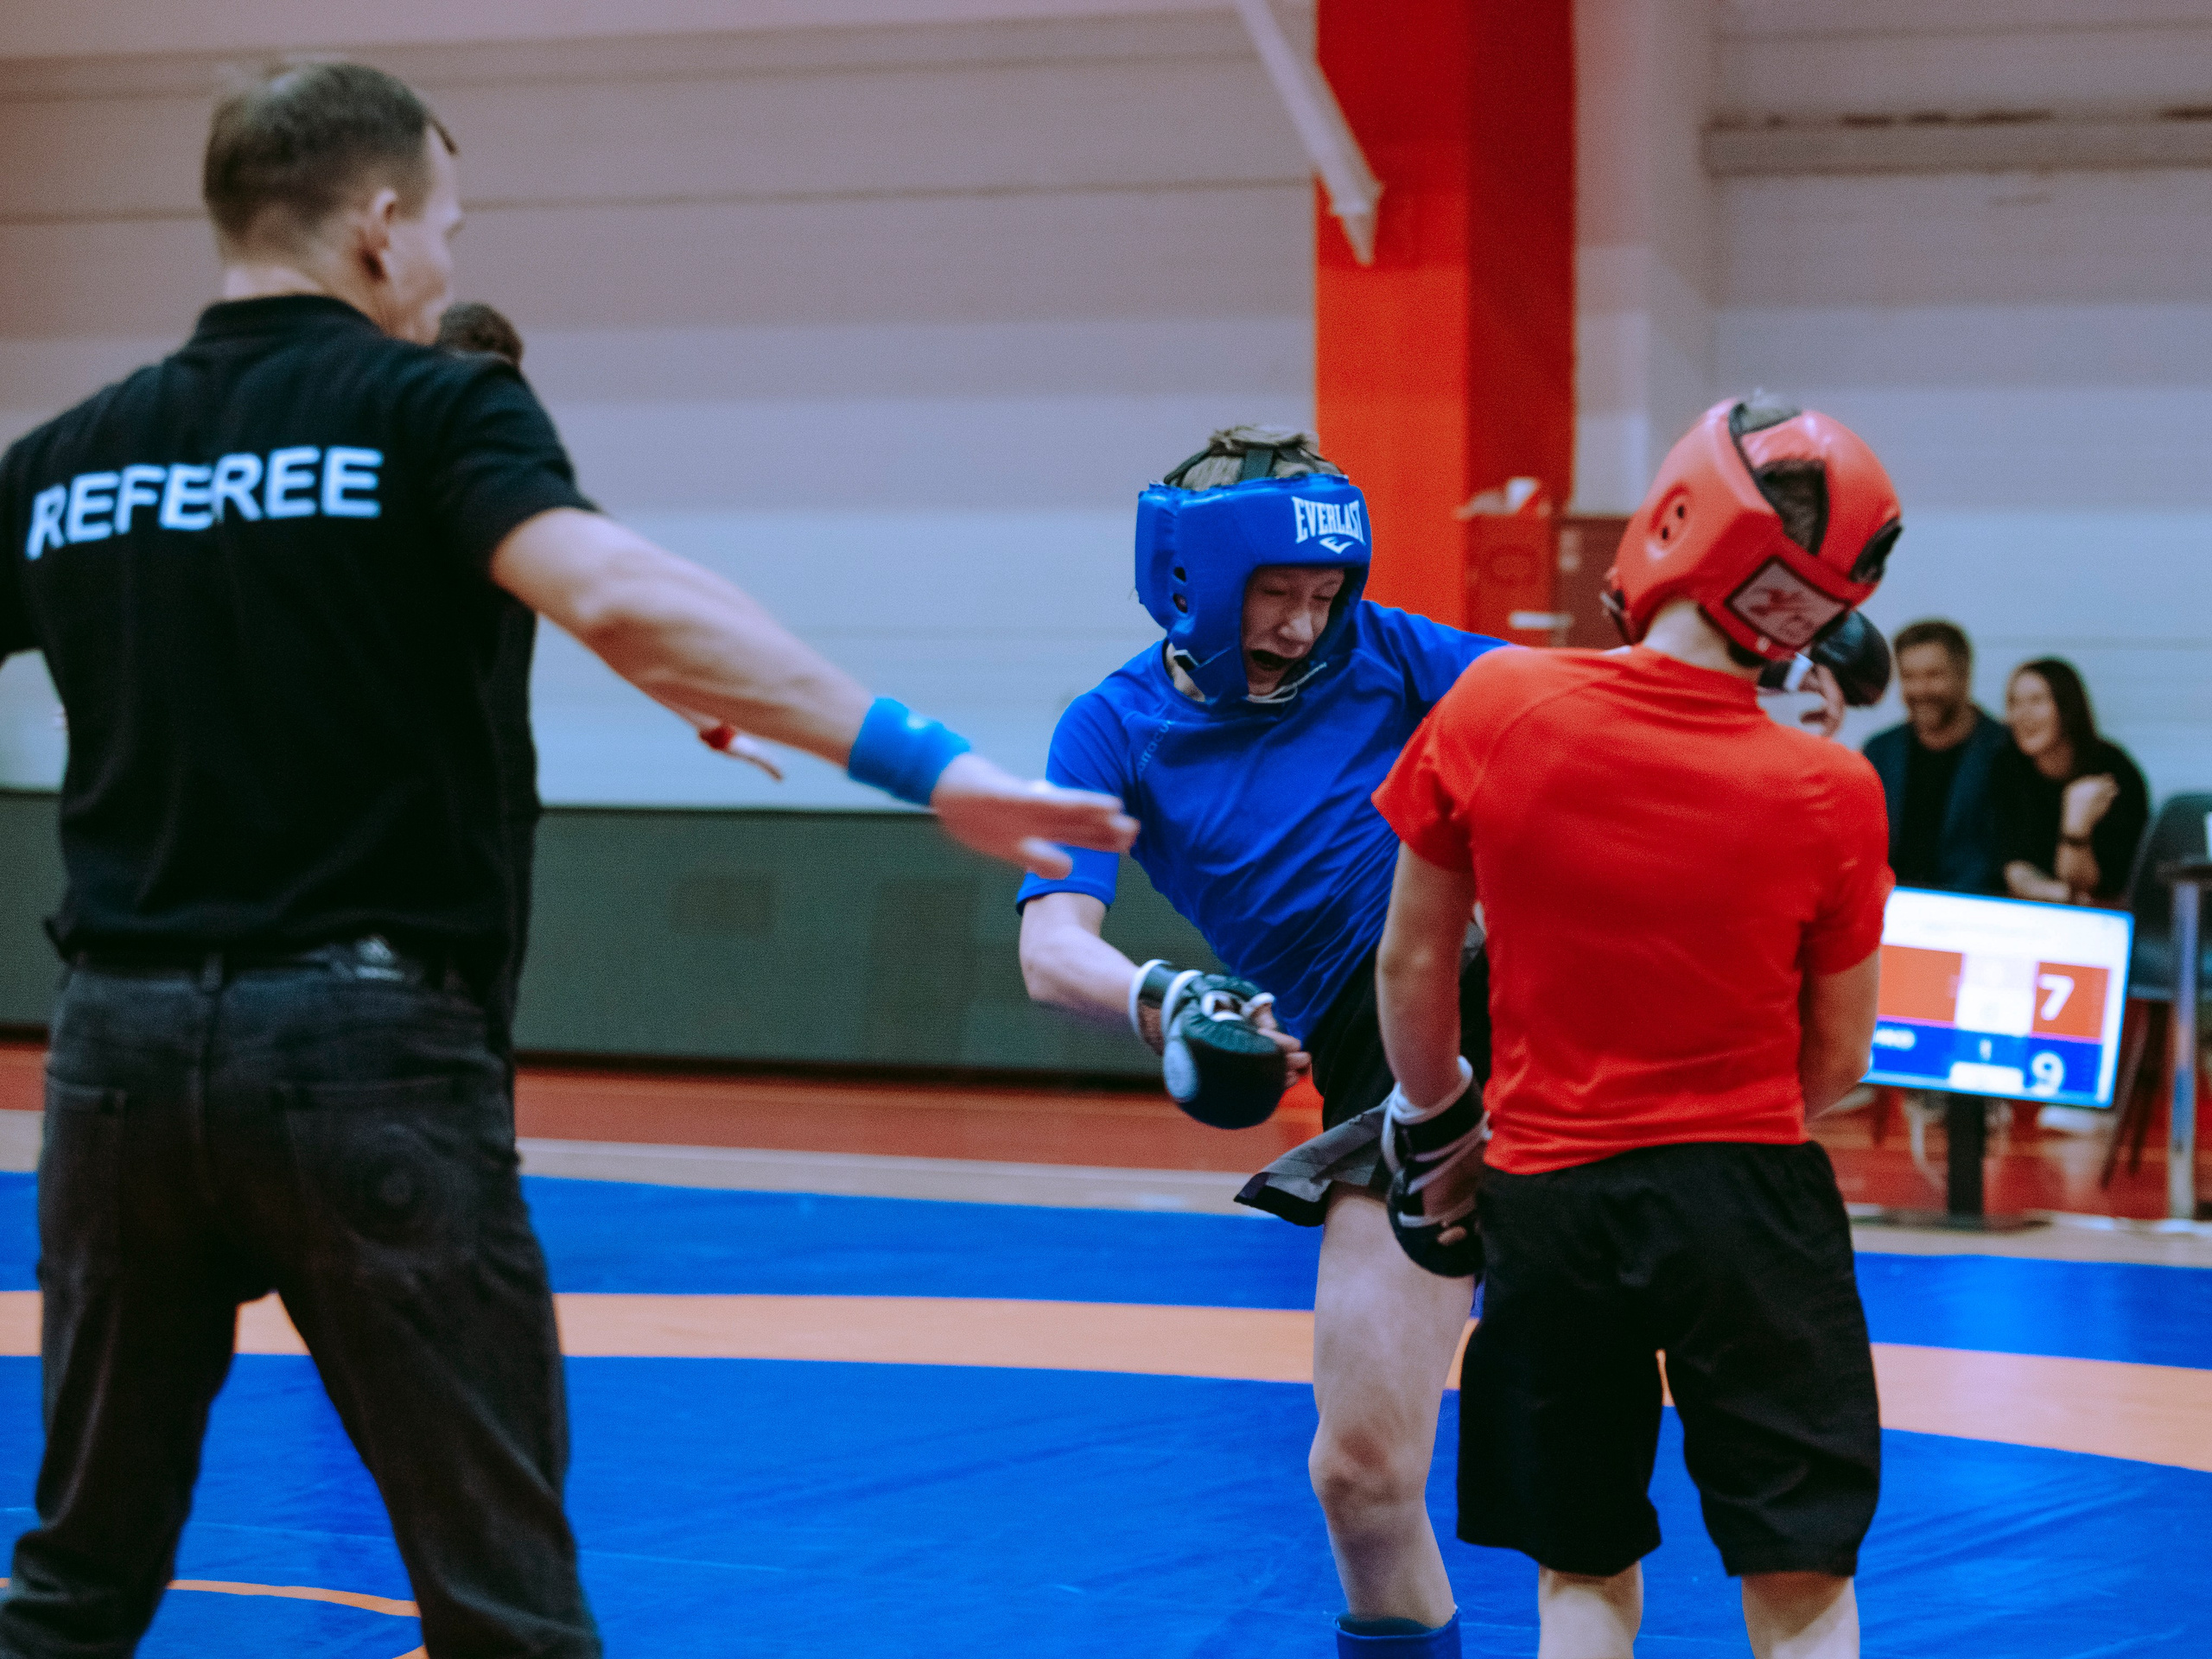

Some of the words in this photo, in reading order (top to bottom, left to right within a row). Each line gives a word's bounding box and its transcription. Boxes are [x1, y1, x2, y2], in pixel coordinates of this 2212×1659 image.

[25, 445, 385, 561] REFEREE
[2038, 973, 2075, 1021] 7
[2031, 1051, 2065, 1096] 9
